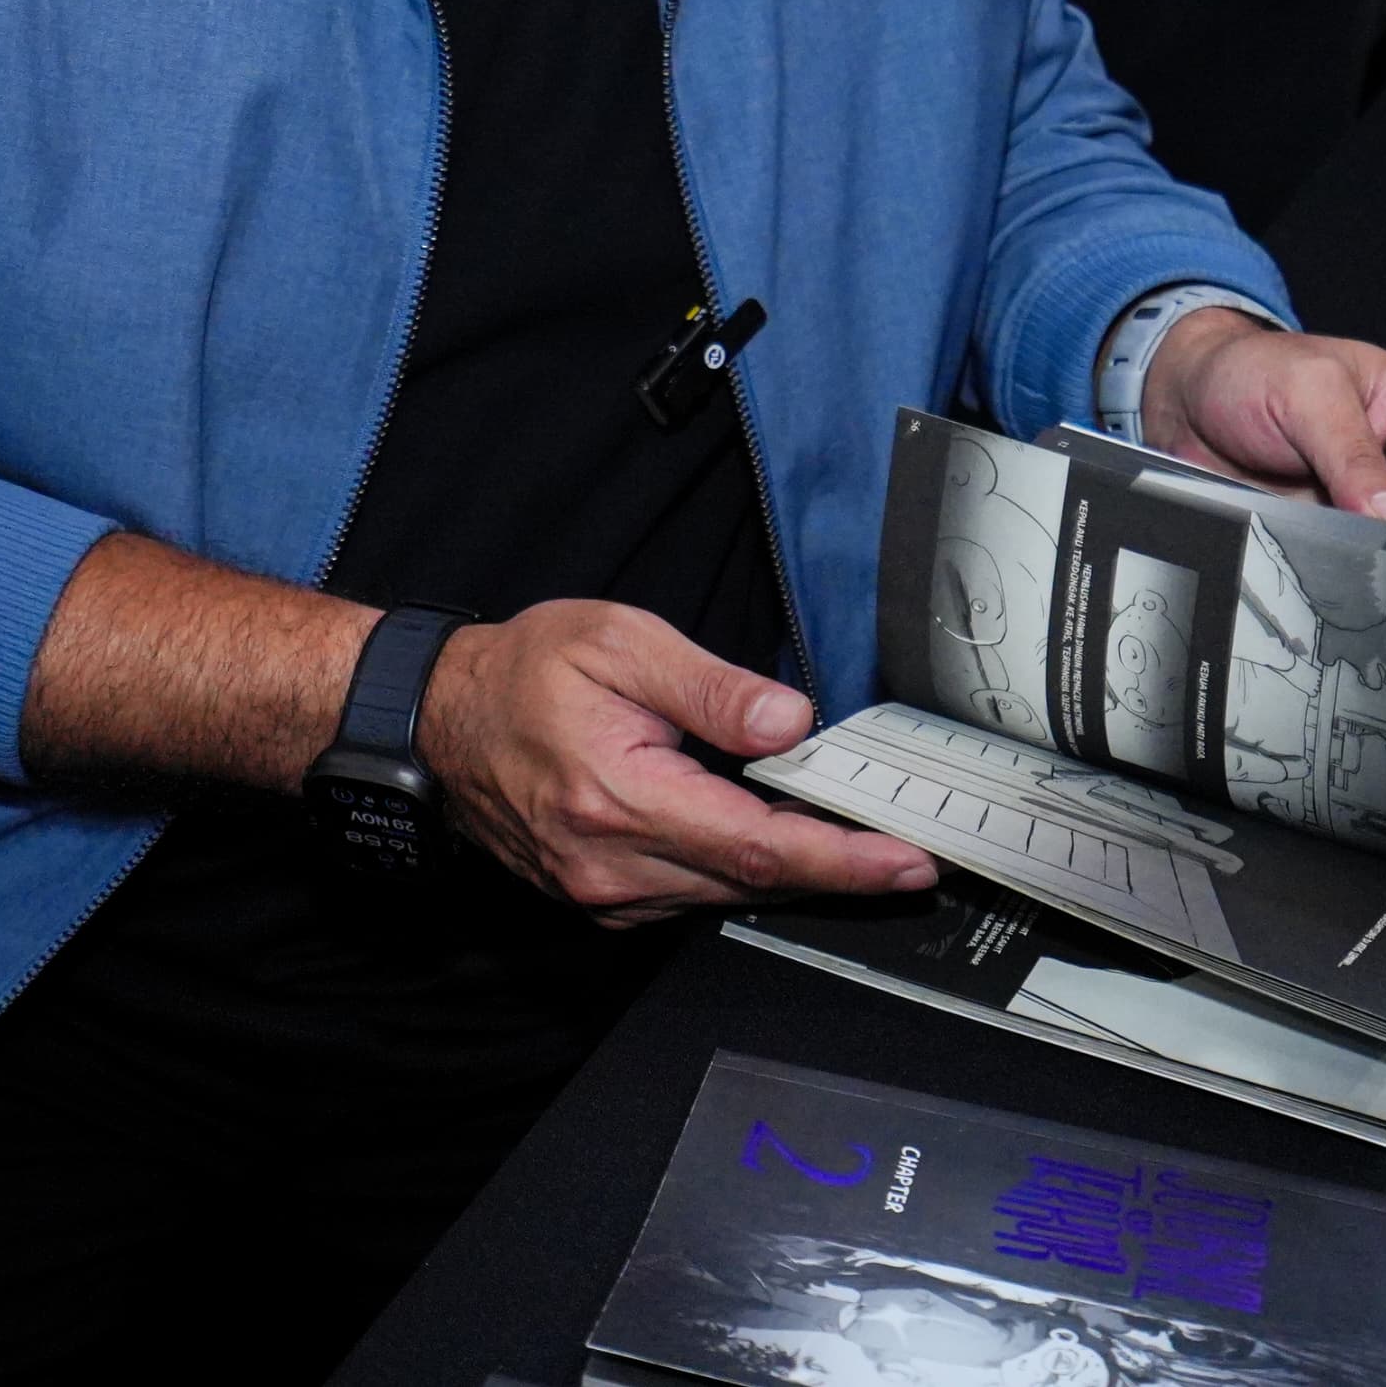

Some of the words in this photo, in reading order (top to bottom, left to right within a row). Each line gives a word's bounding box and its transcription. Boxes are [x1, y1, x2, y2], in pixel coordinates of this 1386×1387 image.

[1074, 499, 1090, 548] KEPALAKU
[1067, 550, 1083, 605] TERDONGAK
[1078, 563, 1093, 613] HEMBUSAN
[1198, 660, 1211, 691] KEDUA
[1196, 690, 1207, 722] KAKIKU
[350, 810, 390, 828] NOV
[392, 818, 416, 833] 29
[740, 1119, 875, 1188] 2
[884, 1145, 921, 1214] CHAPTER
